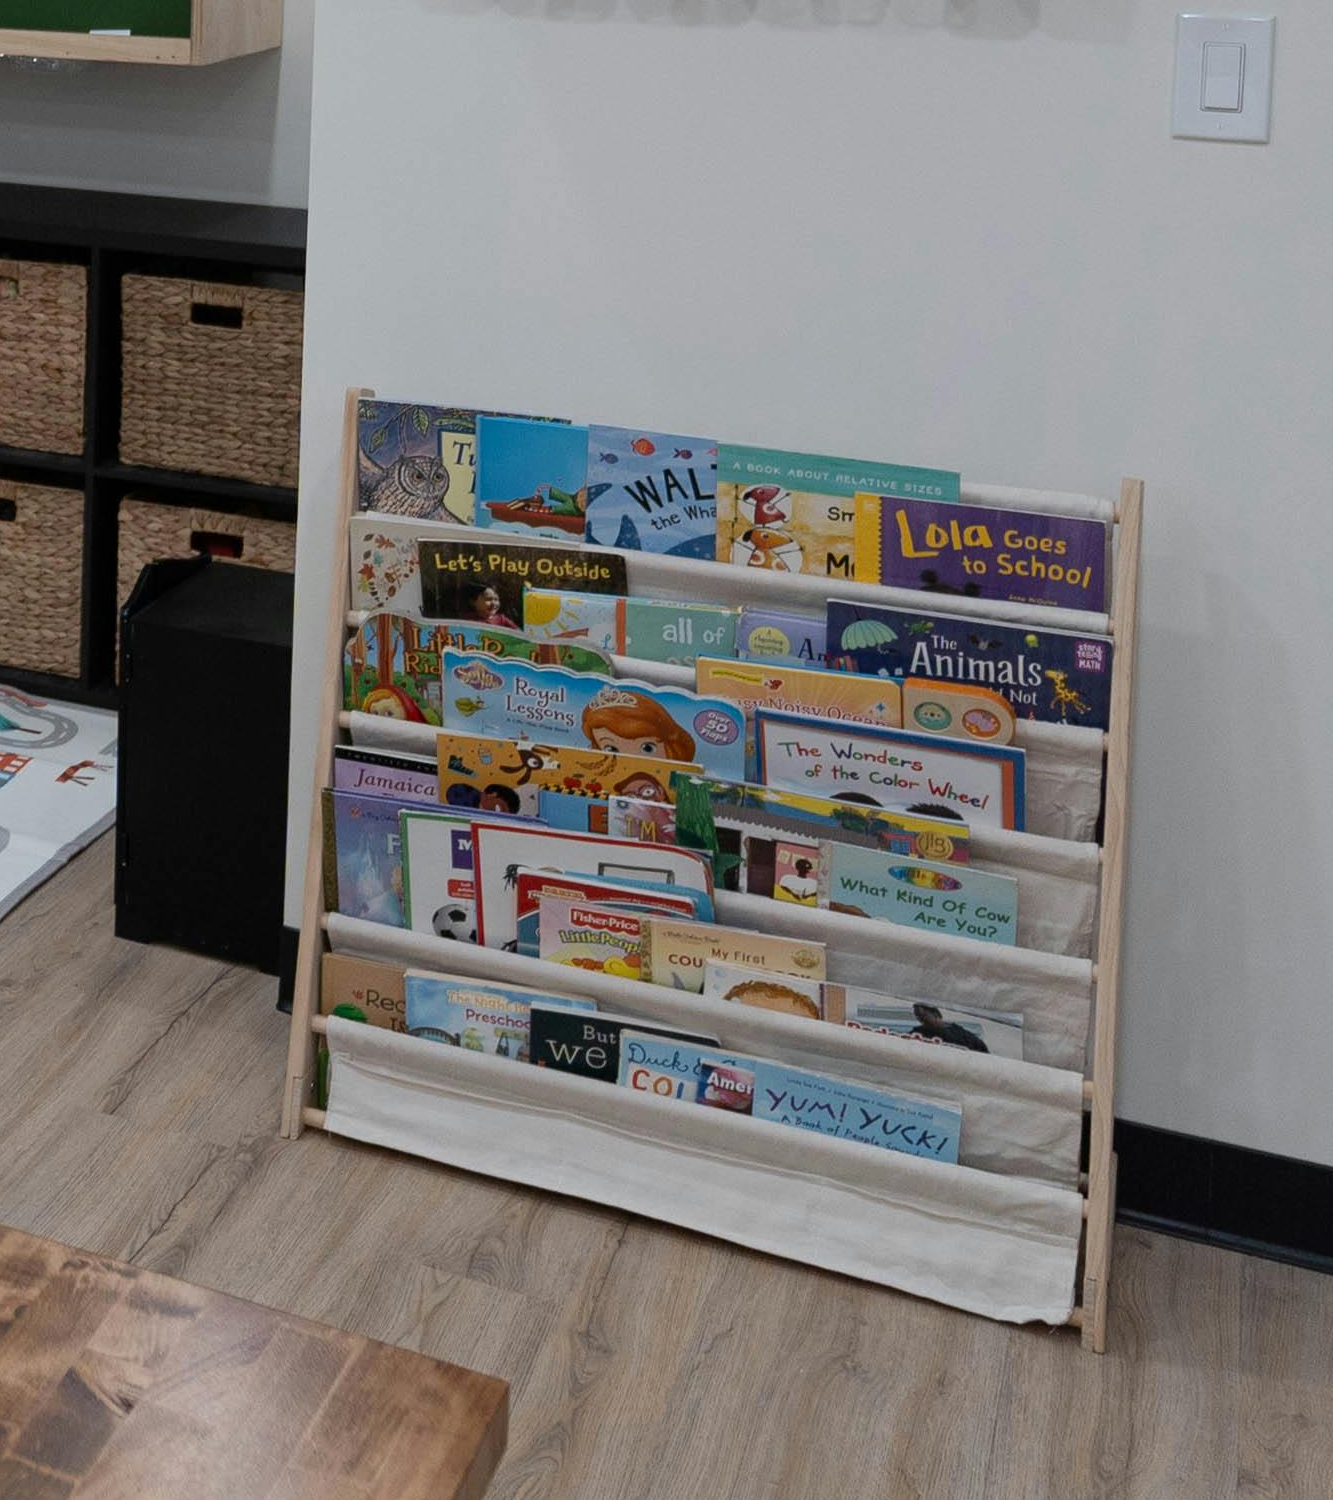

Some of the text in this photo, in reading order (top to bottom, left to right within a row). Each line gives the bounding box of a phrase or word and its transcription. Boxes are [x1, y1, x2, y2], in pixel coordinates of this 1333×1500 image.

[733, 461, 942, 497] A BOOK ABOUT RELATIVE SIZES
[650, 513, 681, 531] the
[895, 508, 1067, 558] Lola Goes
[434, 553, 611, 580] Let's Play Outside
[962, 553, 1092, 589] to School
[662, 617, 693, 644] all
[702, 627, 726, 645] of
[932, 635, 957, 650] The
[910, 642, 1042, 688] Animals
[515, 676, 565, 707] Royal
[1010, 689, 1037, 705] Not
[506, 695, 574, 727] Lessons
[708, 712, 730, 724] Over
[706, 721, 728, 735] 50
[778, 741, 923, 772] The Wonders
[354, 768, 436, 796] Jamaica
[805, 765, 989, 810] of the Color Wheel
[840, 877, 887, 897] What
[896, 889, 933, 908] Kind
[942, 900, 966, 914] Of
[975, 906, 1011, 924] Cow
[572, 910, 639, 931] Fisher-Price
[914, 911, 997, 938] Are You?
[711, 949, 765, 966] My First
[583, 1025, 617, 1044] But
[545, 1039, 607, 1069] we
[628, 1042, 689, 1072] Duck
[765, 1088, 847, 1123] YUM!
[859, 1108, 949, 1154] YUCK!
